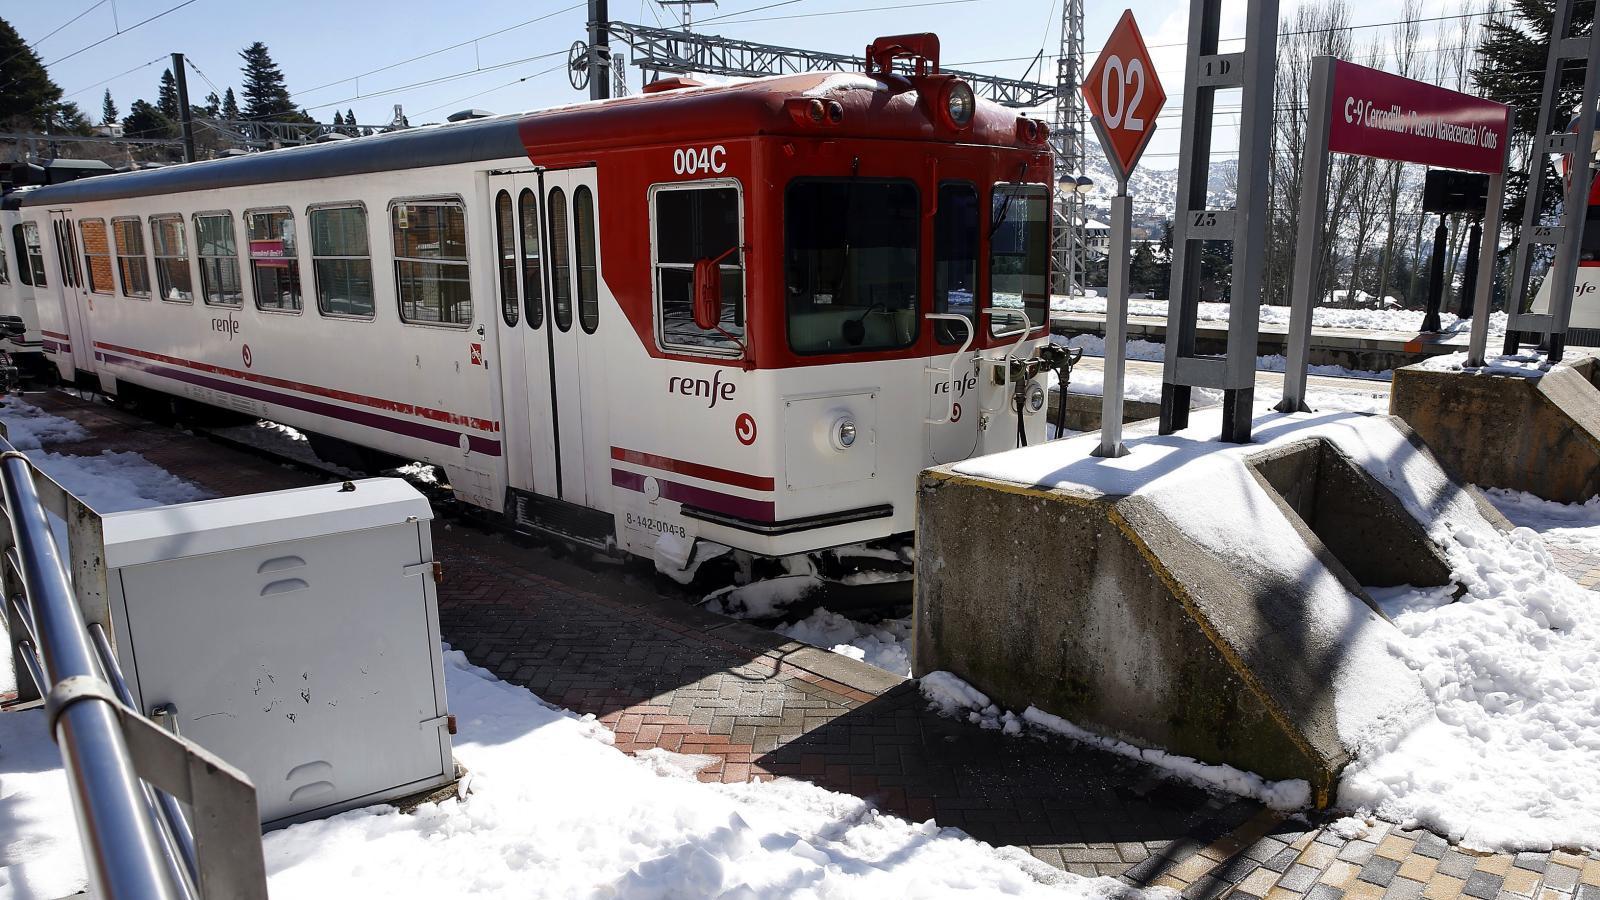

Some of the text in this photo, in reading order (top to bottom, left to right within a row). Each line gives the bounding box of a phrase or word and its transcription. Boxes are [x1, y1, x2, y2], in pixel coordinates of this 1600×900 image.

[1220, 60, 1231, 75] D
[1101, 54, 1145, 131] 02
[1344, 96, 1364, 125] C-9
[1364, 100, 1405, 134] Cercedilla
[1410, 110, 1435, 138] Puerto
[1435, 117, 1477, 146] Navacerrada
[1481, 125, 1498, 150] Cotos
[673, 144, 727, 175] 004C
[1573, 281, 1597, 297] nfe
[211, 311, 240, 342] renfe
[668, 369, 736, 409] renfe
[933, 370, 977, 399] renfe
